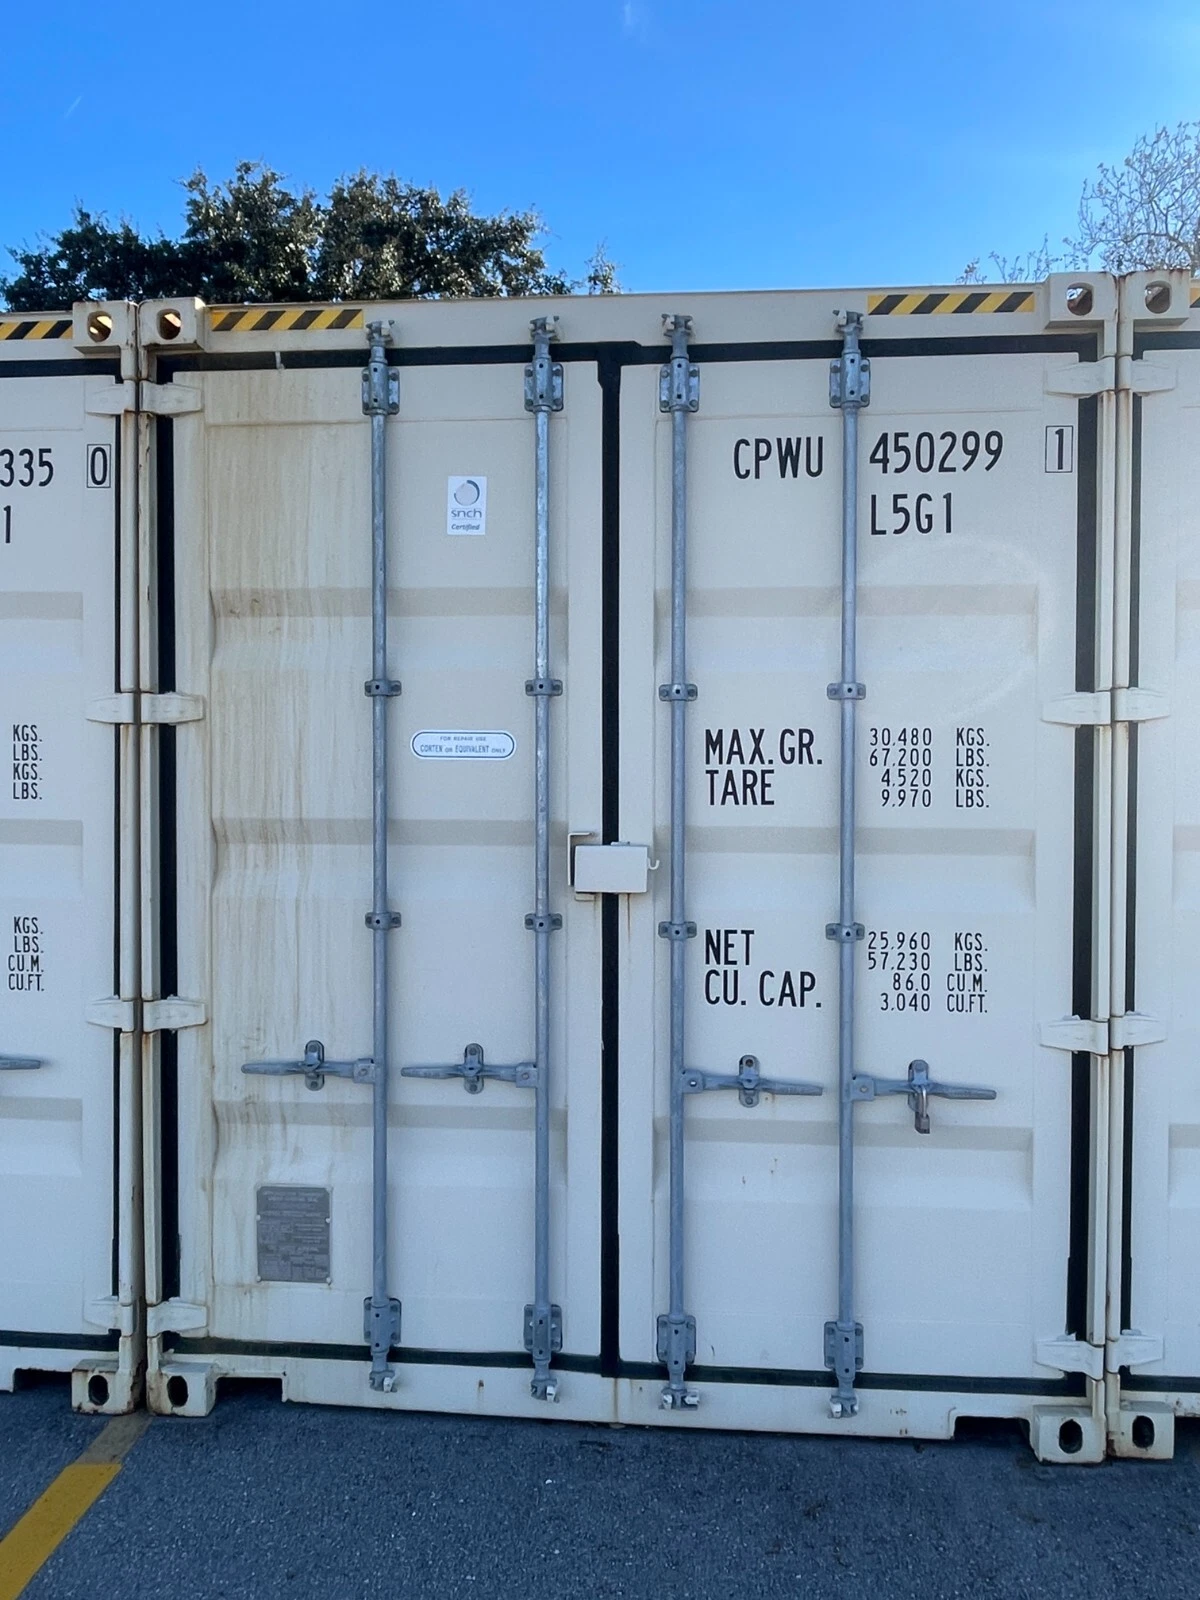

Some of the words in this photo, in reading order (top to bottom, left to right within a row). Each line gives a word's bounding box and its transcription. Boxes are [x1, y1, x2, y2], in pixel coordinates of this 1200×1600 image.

[734, 437, 823, 479] CPWU
[870, 431, 1002, 473] 450299
[1054, 428, 1065, 471] 1
[91, 447, 107, 485] 0
[451, 509, 482, 518] snch
[871, 493, 951, 535] L5G1
[13, 725, 42, 741] KGS.
[957, 728, 989, 746] KGS.
[14, 744, 42, 761] LBS.
[455, 745, 489, 753] EQUIVALENT
[957, 748, 989, 766] LBS.
[14, 763, 42, 780] KGS.
[956, 769, 989, 787] KGS.
[14, 782, 42, 799] LBS.
[706, 770, 774, 805] TARE
[956, 789, 989, 807] LBS.
[14, 917, 42, 934] KGS.
[15, 936, 43, 953] LBS.
[706, 930, 754, 965] NET
[955, 933, 987, 951] KGS.
[9, 955, 43, 972] CU.M.
[955, 953, 987, 971] LBS.
[9, 974, 44, 991] CU.FT.
[705, 970, 746, 1005] CU.
[760, 971, 821, 1007] CAP.
[947, 974, 987, 992] CU.M.
[947, 994, 987, 1012] CU.FT.
